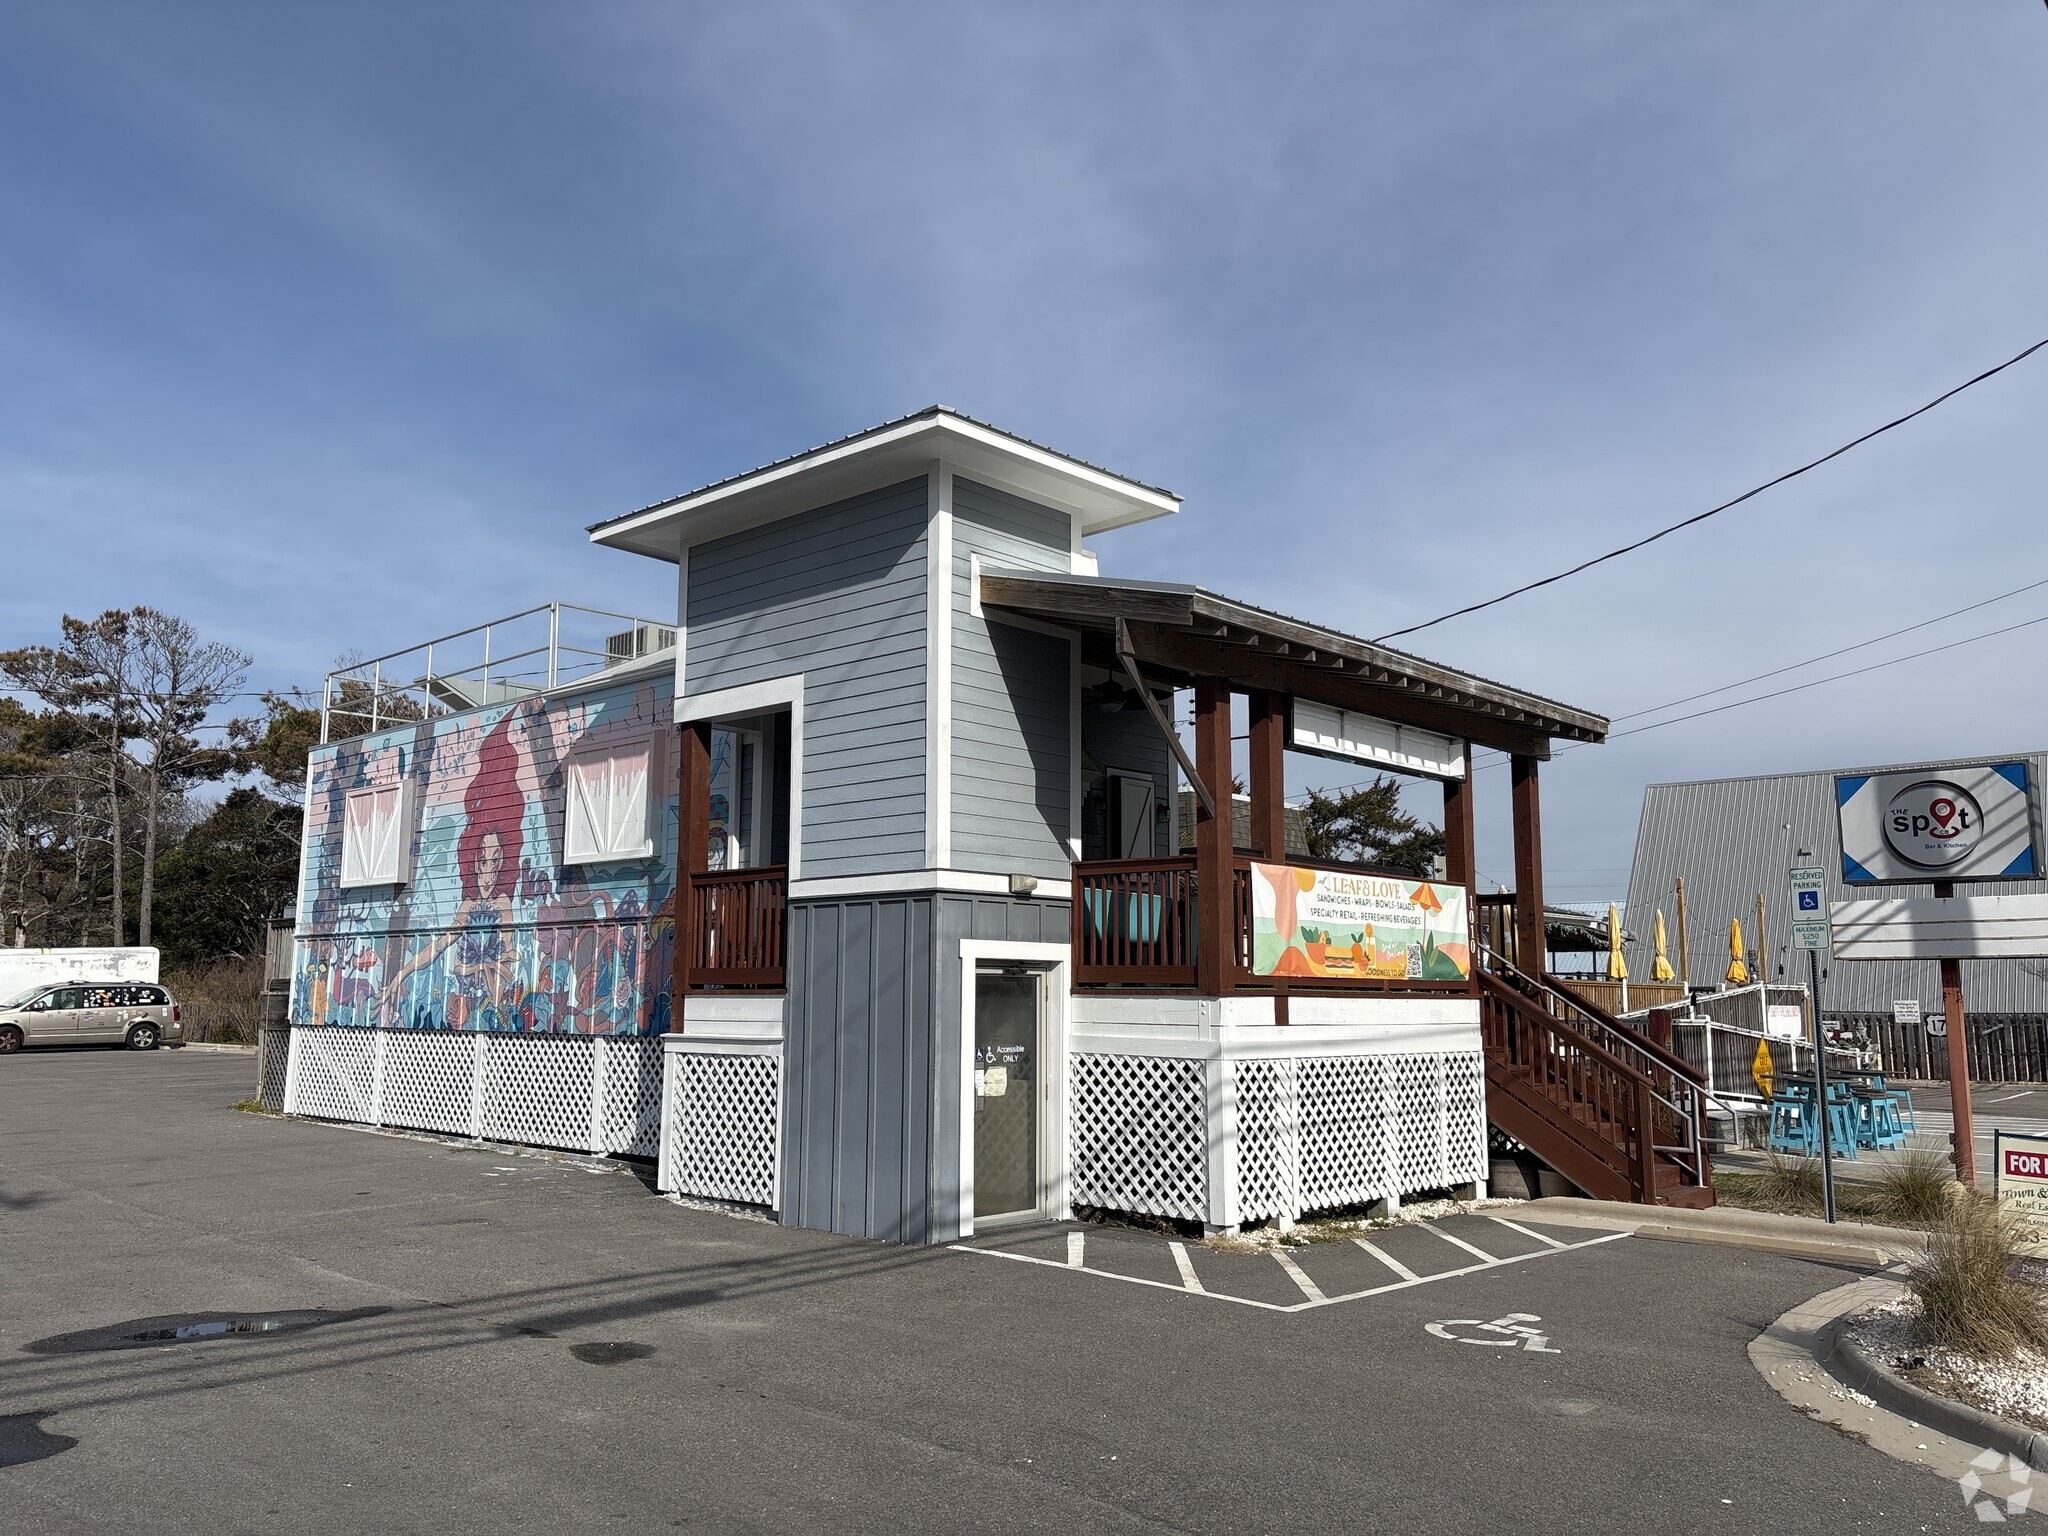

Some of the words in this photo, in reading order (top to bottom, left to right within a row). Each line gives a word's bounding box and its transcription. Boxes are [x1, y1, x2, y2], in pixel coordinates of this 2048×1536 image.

[1891, 808, 1909, 816] THE
[1790, 872, 1823, 881] RESERVED
[1793, 881, 1821, 889] PARKING
[1317, 894, 1350, 905] SANDWICHES
[1355, 898, 1372, 907] WRAPS
[1375, 899, 1394, 909] BOWLS
[1397, 901, 1415, 911] SALADS
[1310, 907, 1338, 918] SPECIALTY
[1340, 909, 1357, 920] RETAIL
[1360, 912, 1393, 922] REFRESHING
[1393, 914, 1421, 925] BEVERAGES
[1365, 968, 1390, 977] GOODNESS
[1931, 1019, 1946, 1032] 17
[997, 1045, 1025, 1053] Accessible
[1003, 1054, 1019, 1063] ONLY
[2010, 1154, 2041, 1174] FOR
[2002, 1189, 2035, 1199] Town
[2015, 1200, 2035, 1209] Real
